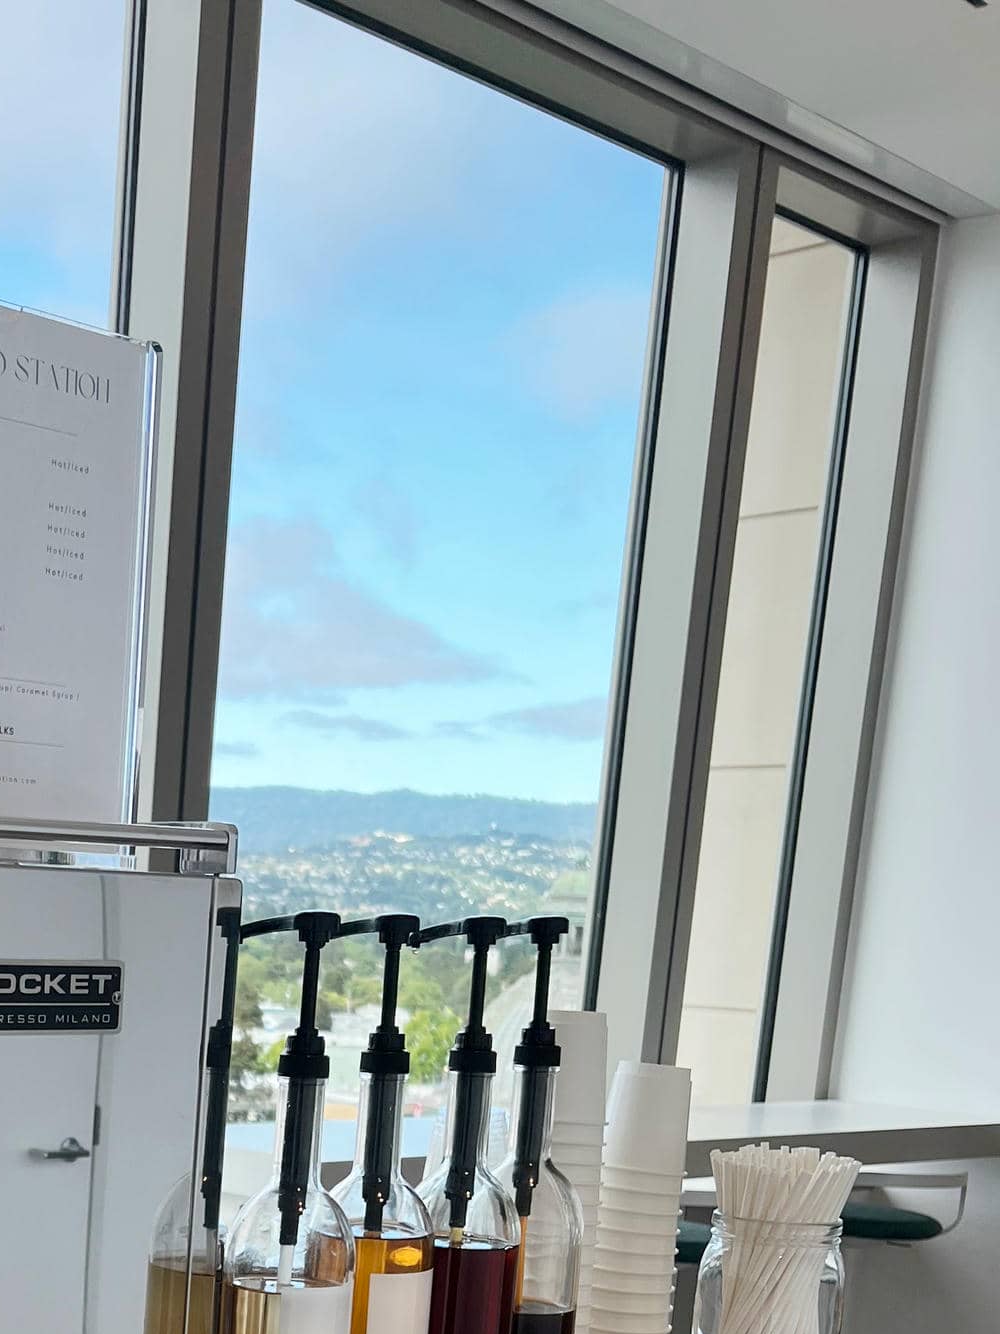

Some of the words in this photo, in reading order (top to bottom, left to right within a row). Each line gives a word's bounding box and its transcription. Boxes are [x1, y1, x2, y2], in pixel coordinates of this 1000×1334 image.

[14, 354, 110, 404] STATION
[51, 458, 89, 474] Hot/Iced
[48, 502, 87, 518] Hot/Iced
[47, 523, 85, 539] Hot/Iced
[46, 545, 84, 560] Hot/Iced
[45, 567, 83, 581] Hot/Iced
[16, 686, 48, 697] Caramel
[55, 1013, 111, 1024] MILANO
